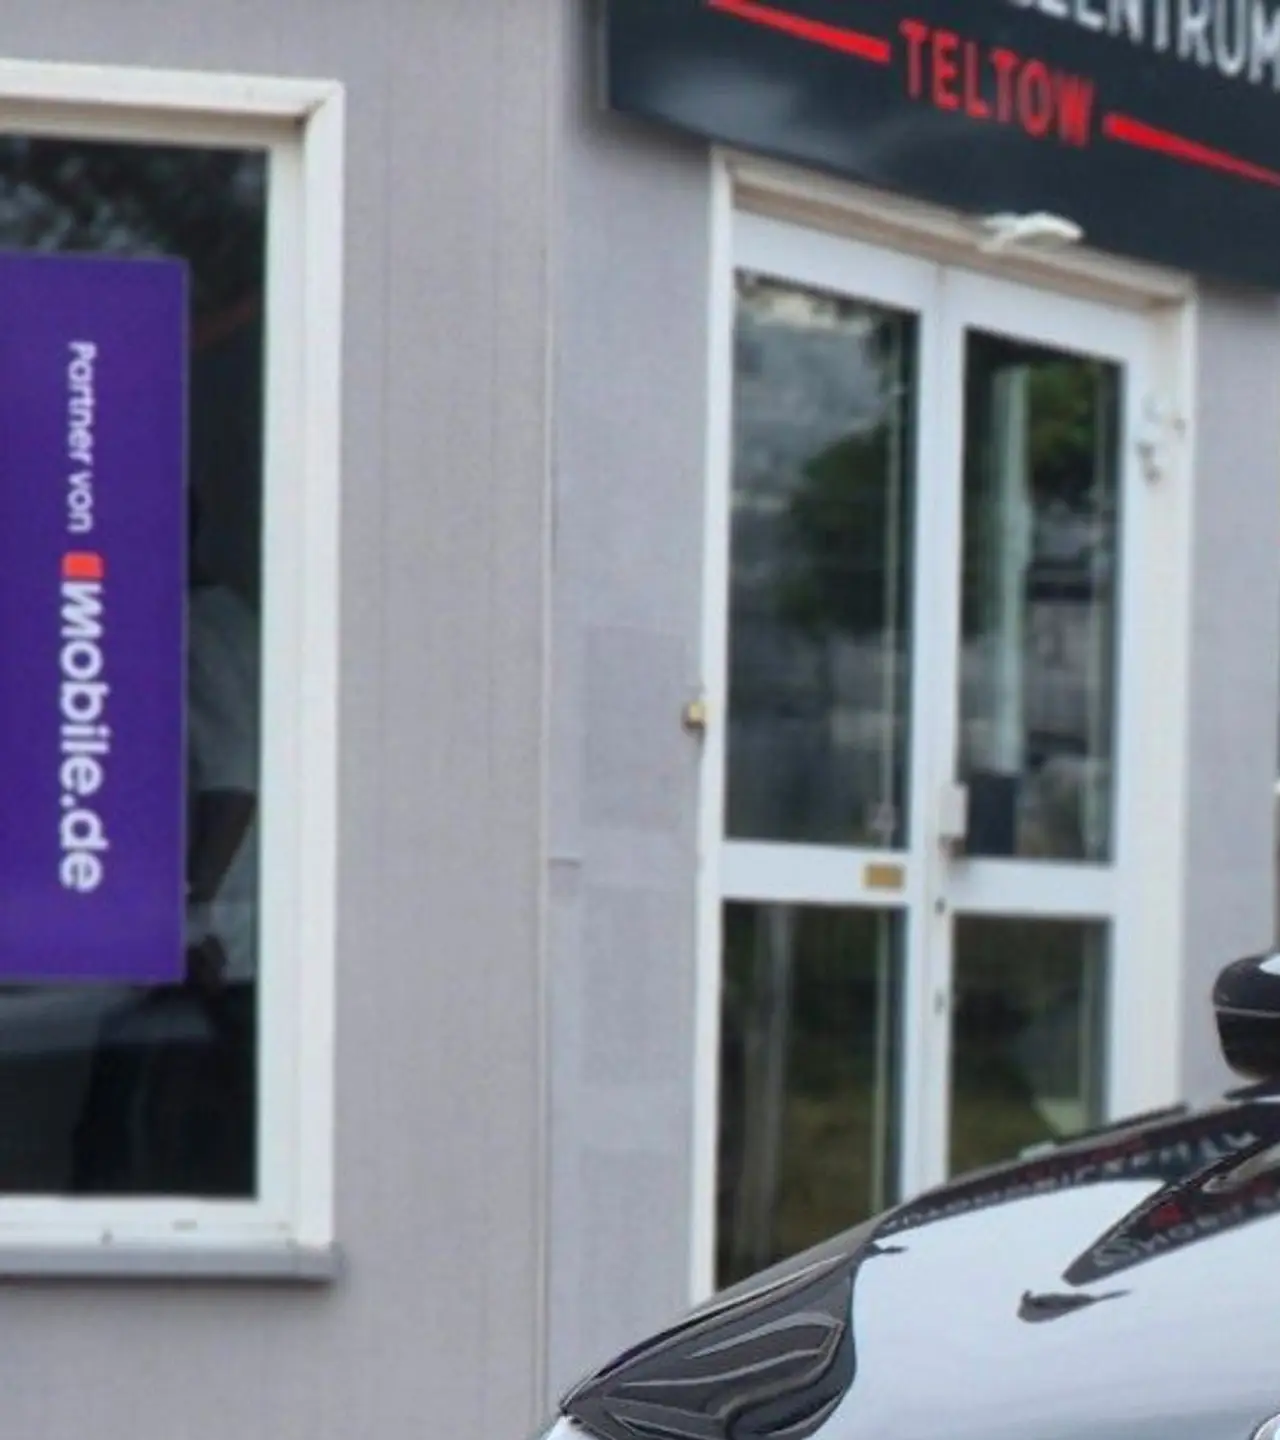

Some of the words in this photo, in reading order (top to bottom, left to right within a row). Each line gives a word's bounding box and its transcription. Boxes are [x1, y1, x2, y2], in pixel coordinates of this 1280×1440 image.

[901, 18, 1094, 147] TELTOW
[66, 341, 97, 466] Partner
[67, 468, 94, 534] von
[60, 580, 111, 893] mobile.de
